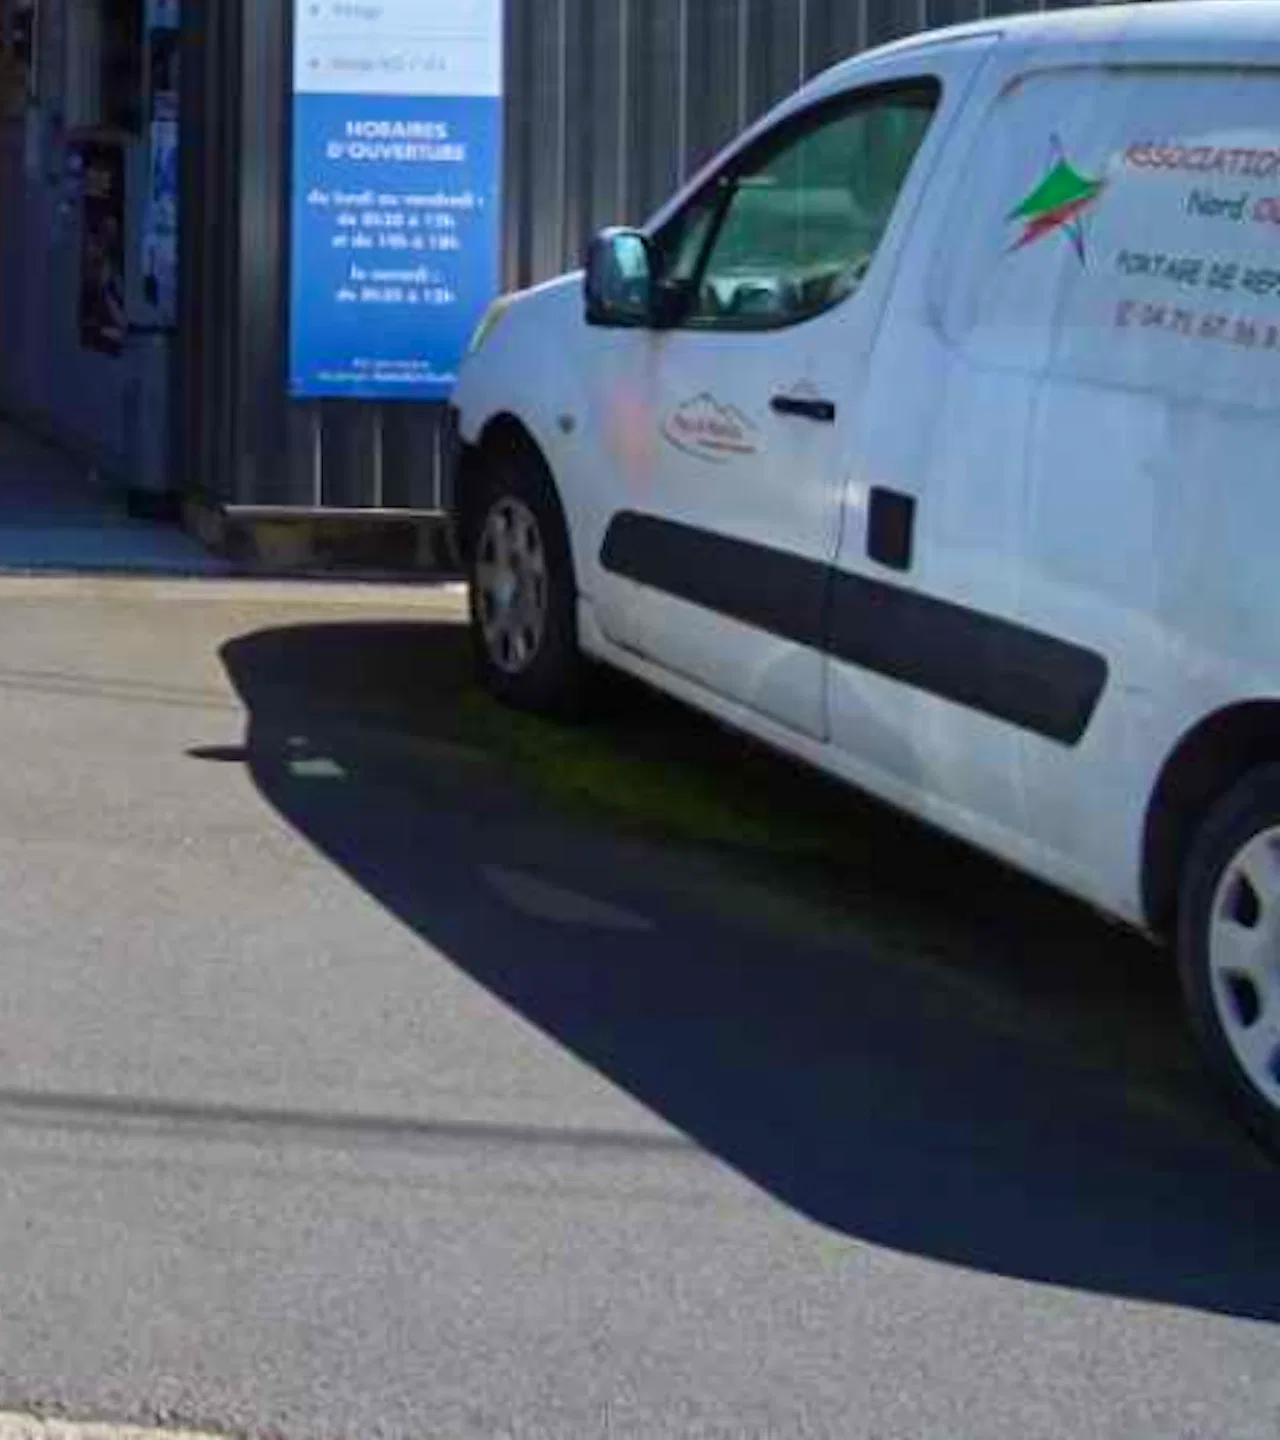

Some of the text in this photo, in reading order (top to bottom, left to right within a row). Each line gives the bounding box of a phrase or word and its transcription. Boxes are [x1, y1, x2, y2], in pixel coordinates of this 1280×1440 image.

[346, 120, 448, 139] HORAIRES
[326, 141, 465, 161] D'OUVERTURE
[1125, 144, 1280, 179] ASSOCIATIO
[1241, 266, 1280, 297] REP
